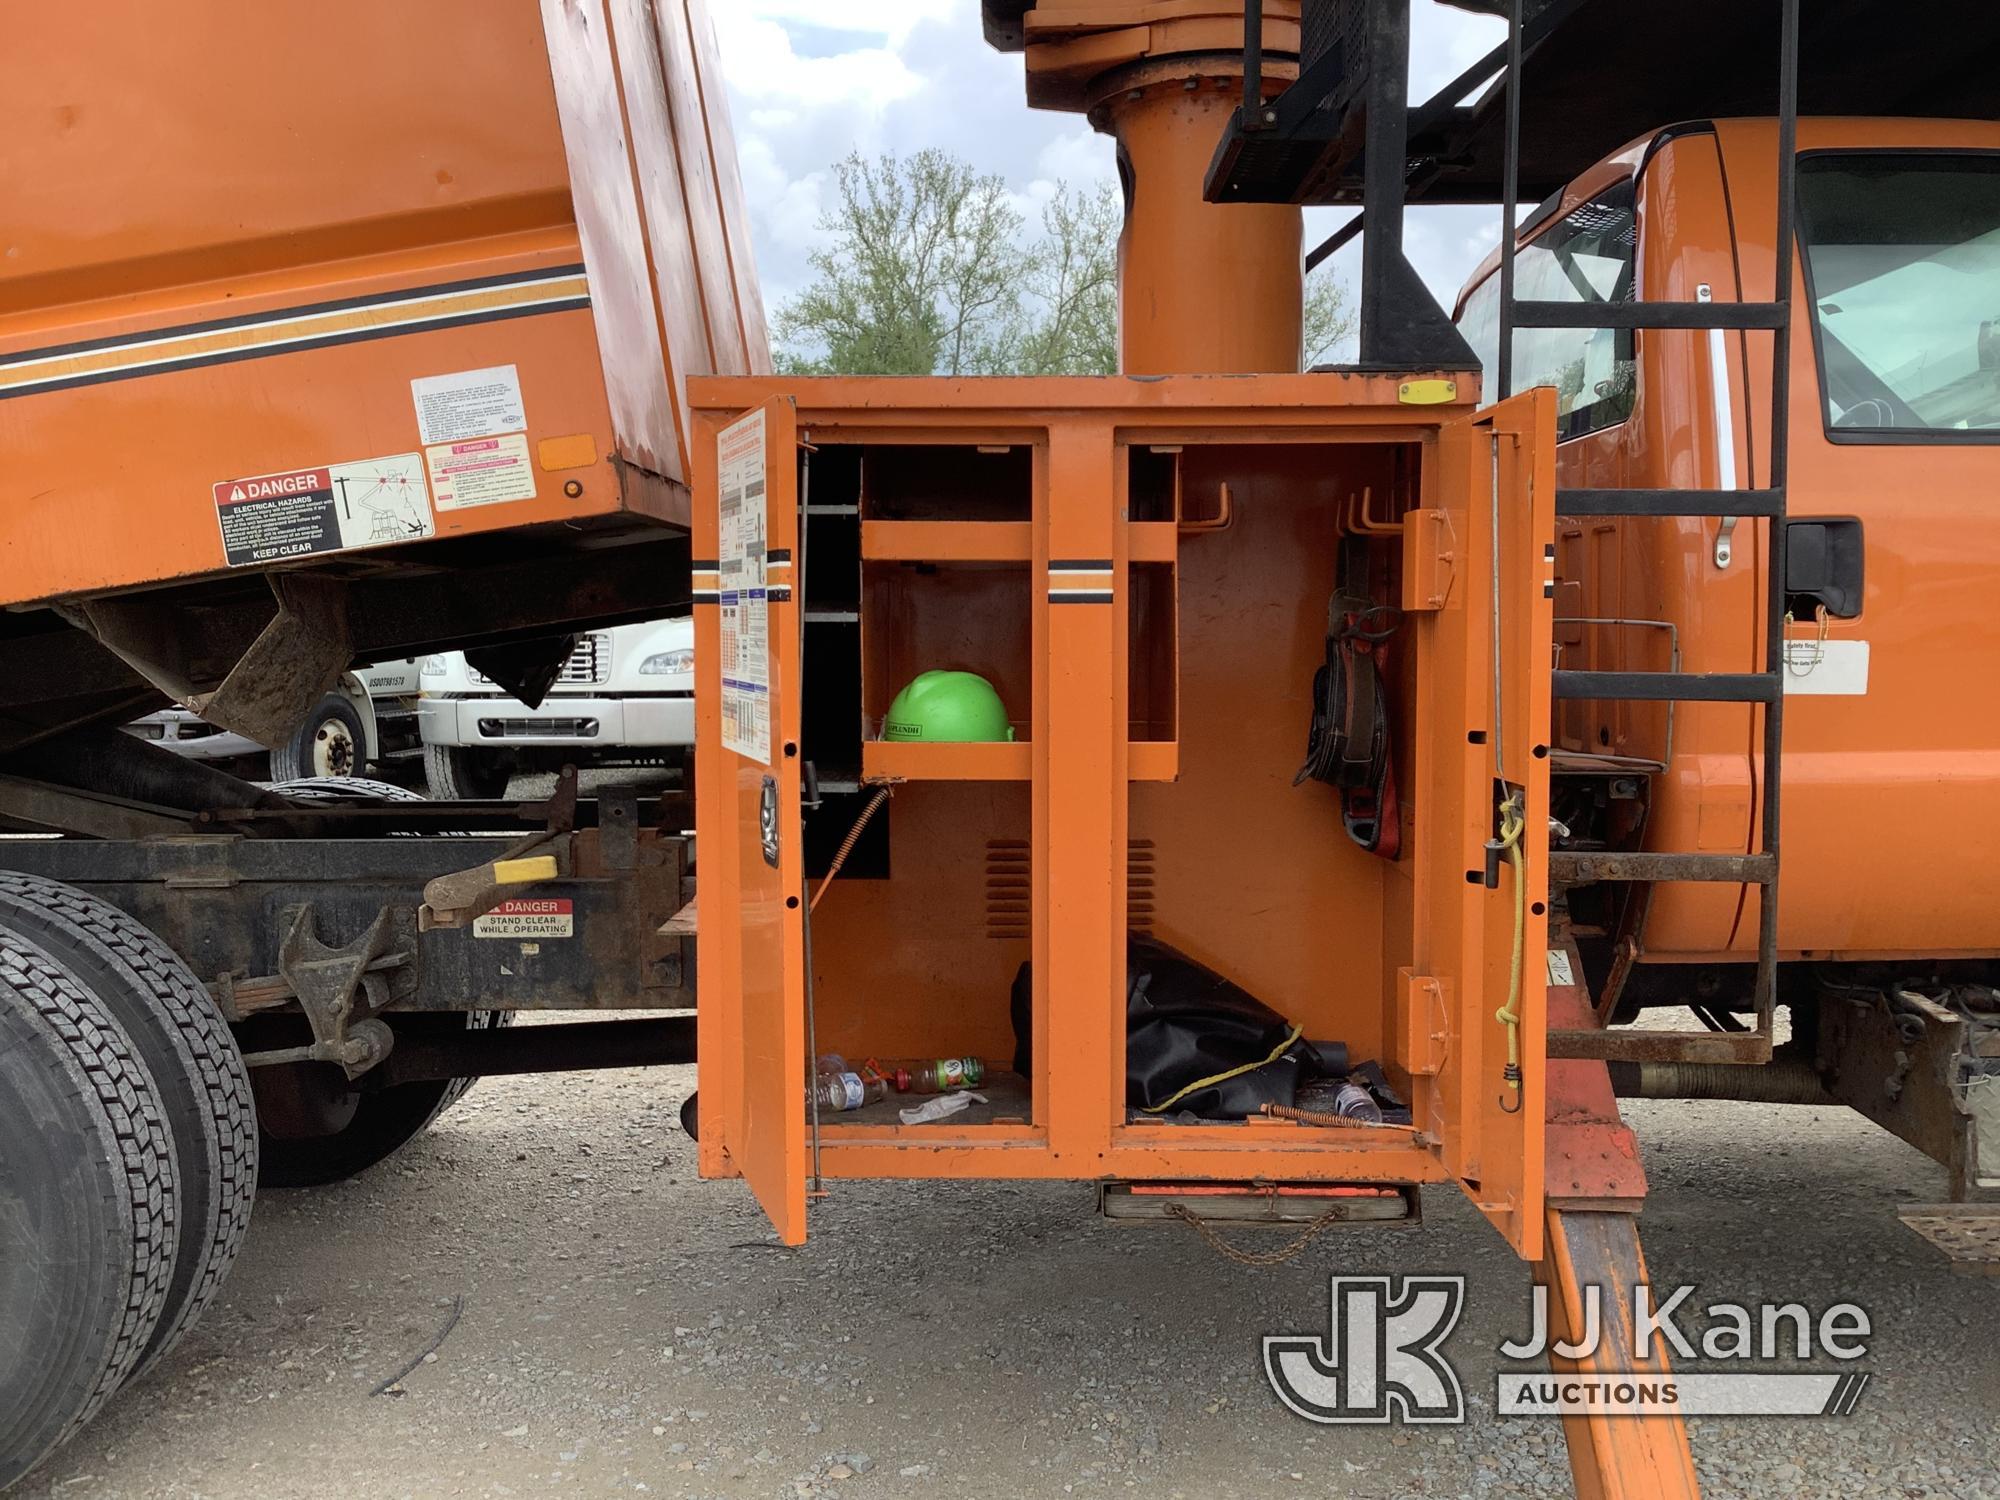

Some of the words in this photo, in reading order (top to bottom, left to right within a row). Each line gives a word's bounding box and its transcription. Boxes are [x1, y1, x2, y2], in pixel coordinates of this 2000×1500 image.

[248, 474, 318, 498] DANGER
[234, 501, 276, 513] ELECTRICAL
[278, 496, 312, 506] HAZARDS
[252, 547, 278, 559] KEEP
[279, 542, 312, 555] CLEAR
[505, 902, 558, 912] DANGER
[490, 916, 520, 924] STAND
[525, 916, 556, 924] CLEAR
[514, 925, 566, 933] OPERATING
